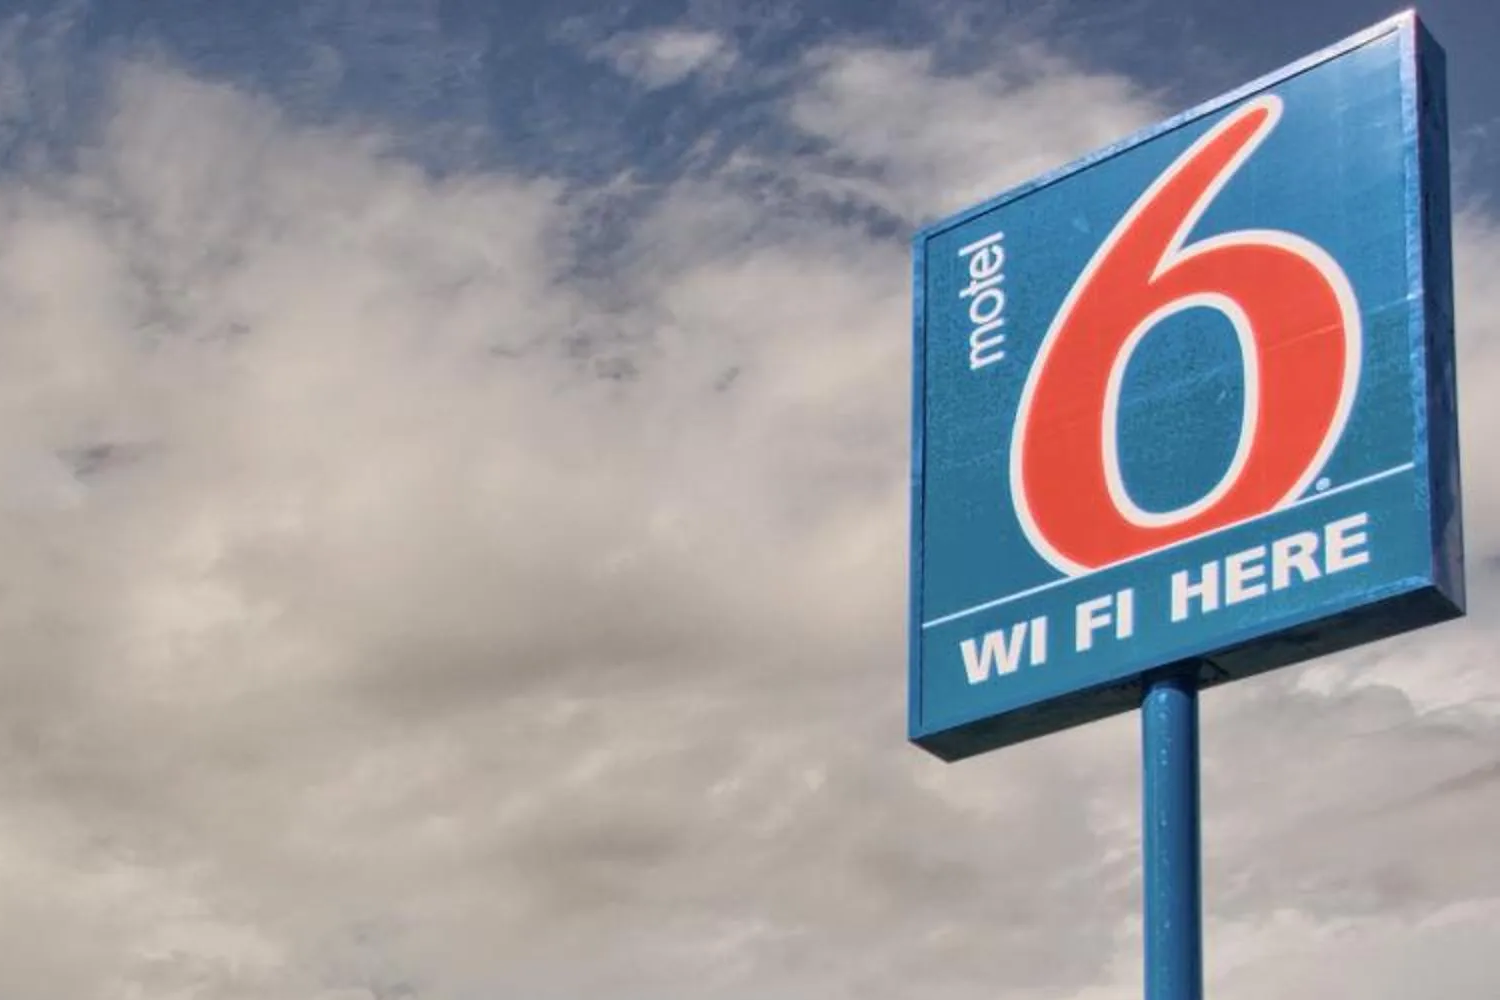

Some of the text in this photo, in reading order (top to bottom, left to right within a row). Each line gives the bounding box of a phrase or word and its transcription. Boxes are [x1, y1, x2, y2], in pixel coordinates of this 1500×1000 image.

[958, 231, 1004, 371] motel
[1009, 94, 1362, 578] 6
[959, 512, 1370, 685] WI FI HERE
